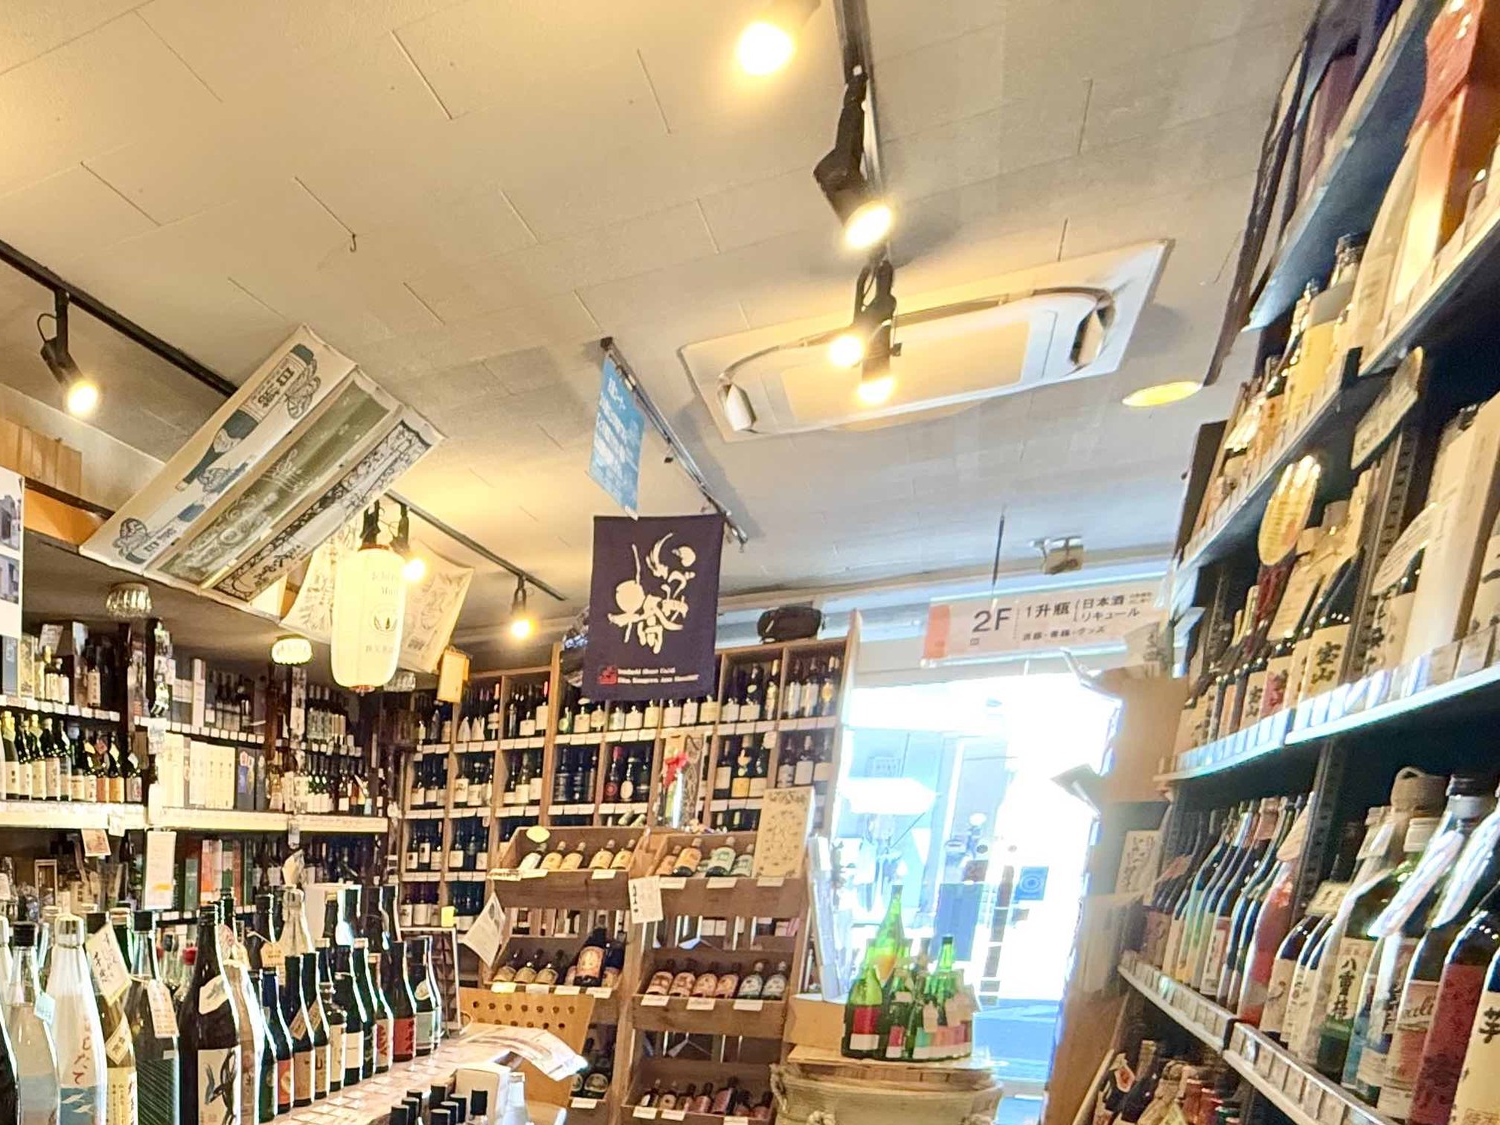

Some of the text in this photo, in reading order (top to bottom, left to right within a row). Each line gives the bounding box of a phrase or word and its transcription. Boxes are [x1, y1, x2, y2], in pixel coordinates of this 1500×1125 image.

[972, 606, 1013, 633] 2F
[1025, 594, 1126, 620] 1升瓶 日本酒
[1080, 607, 1141, 622] リキュール
